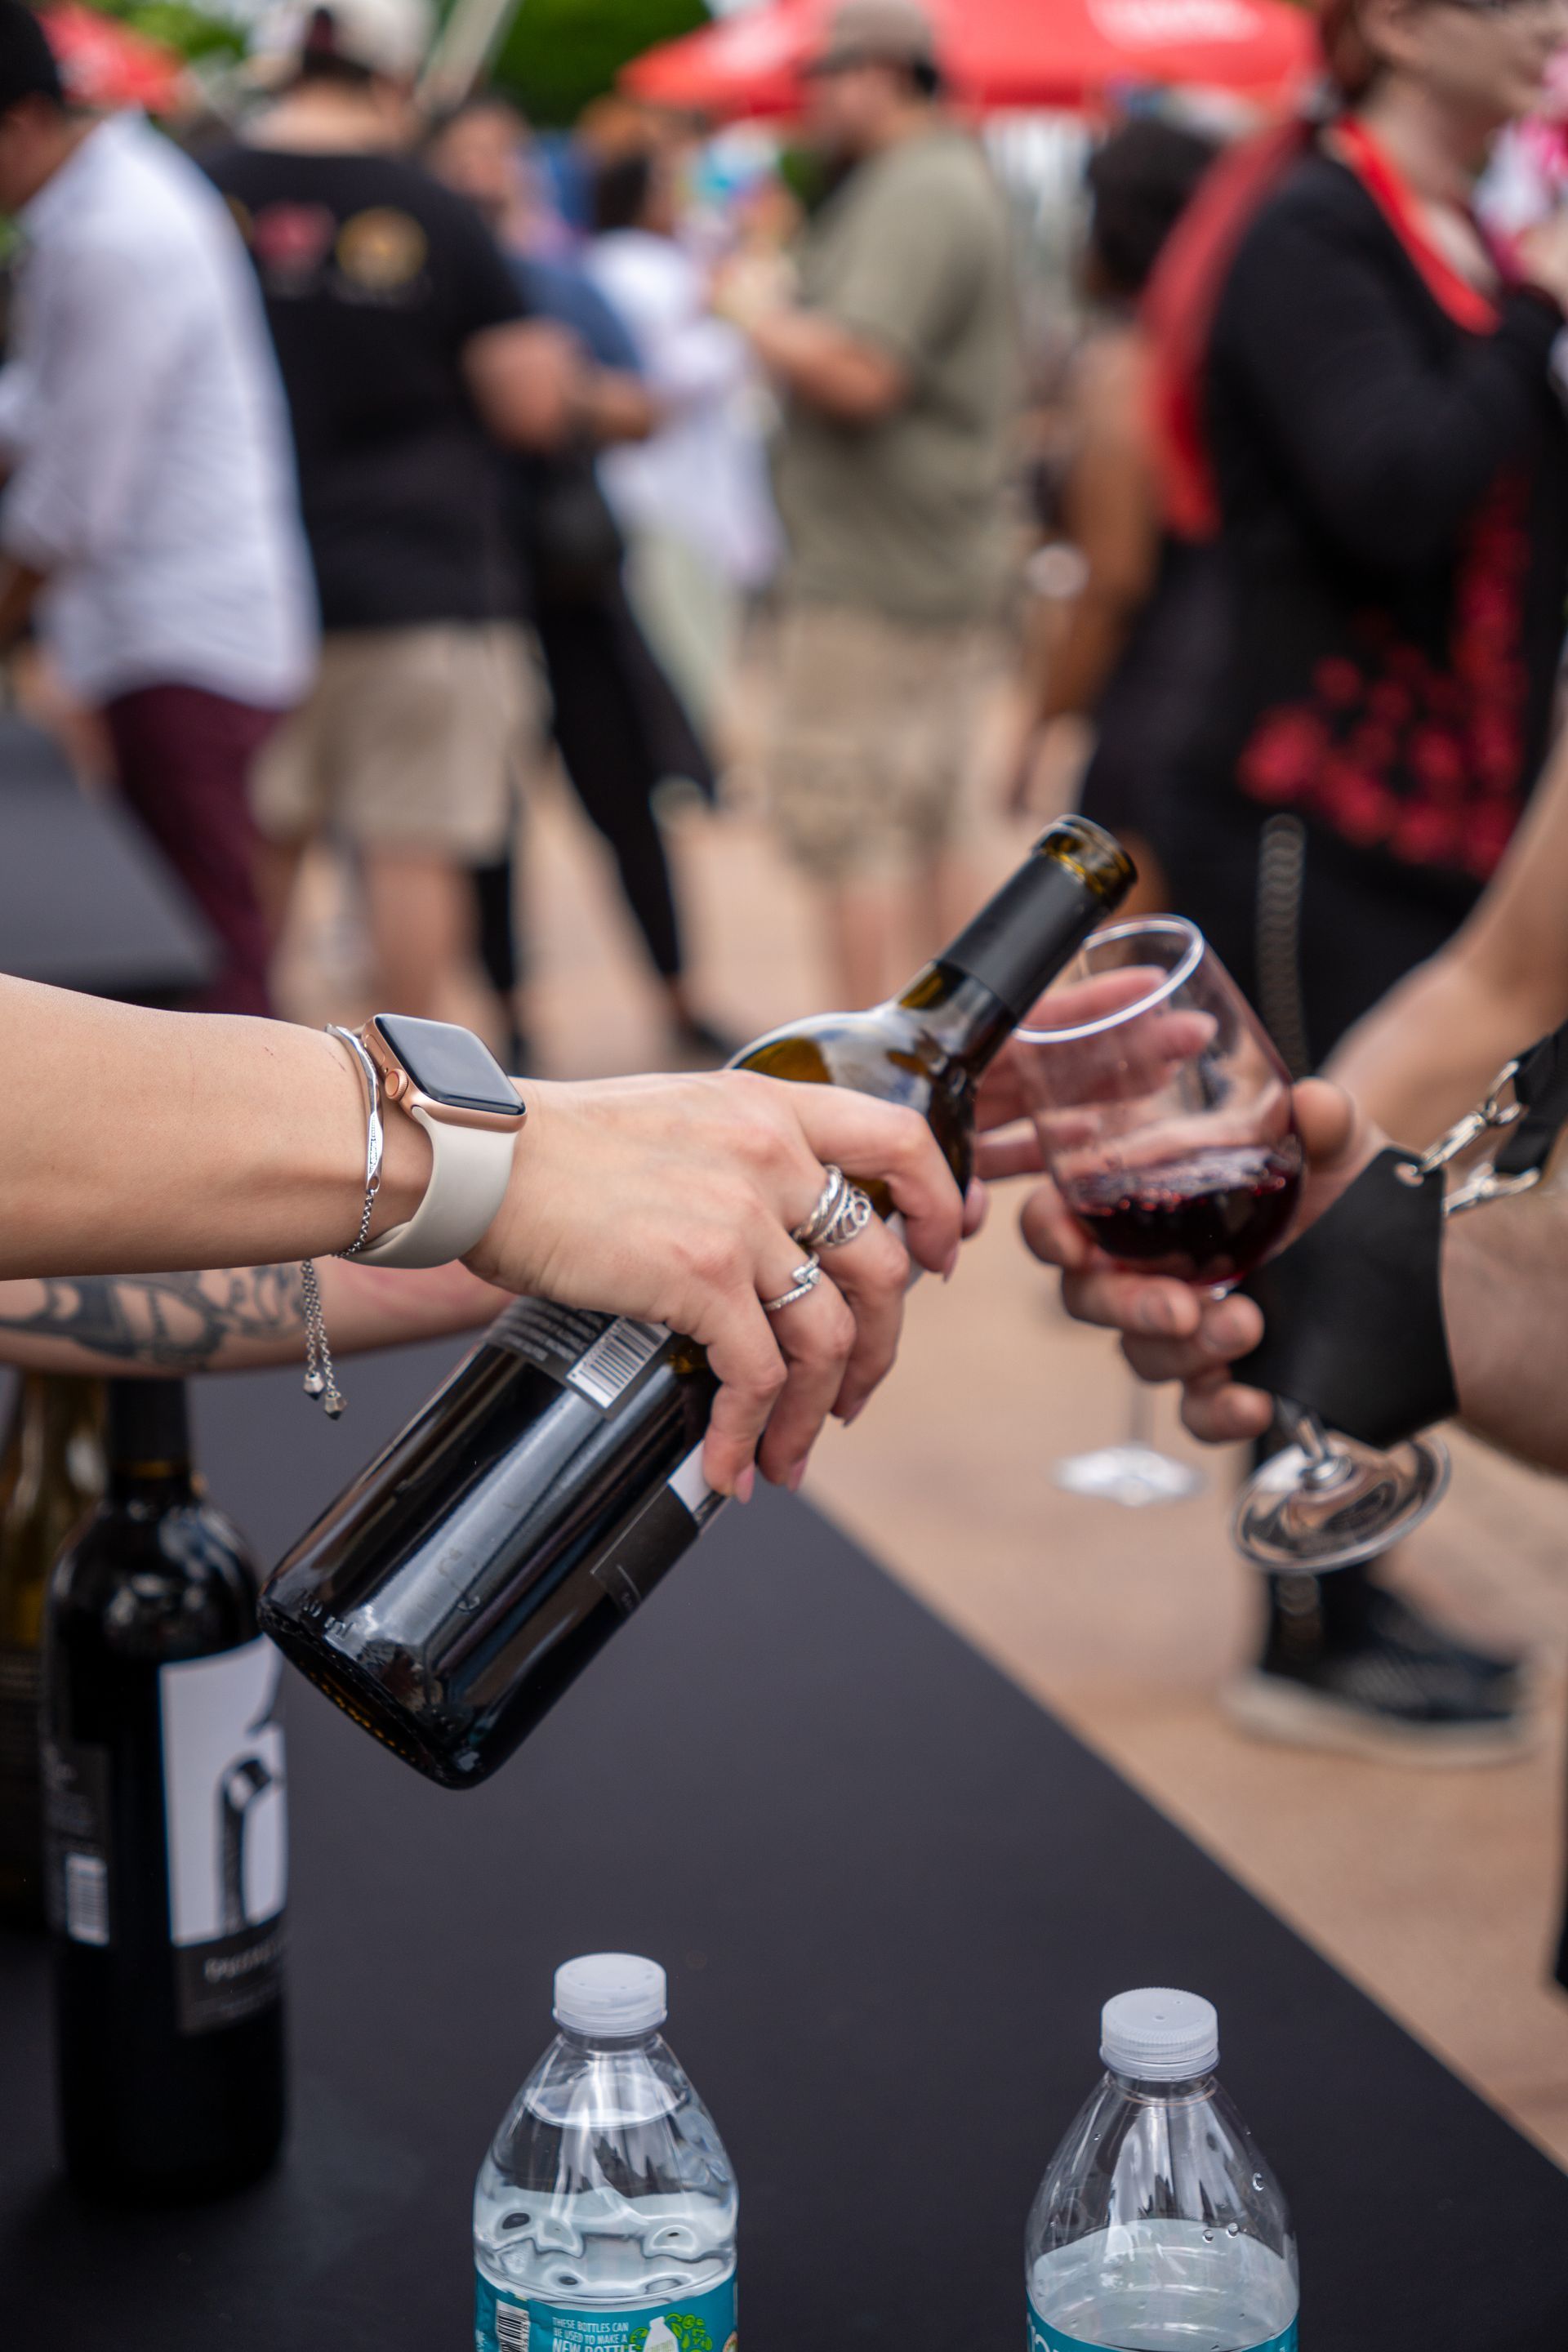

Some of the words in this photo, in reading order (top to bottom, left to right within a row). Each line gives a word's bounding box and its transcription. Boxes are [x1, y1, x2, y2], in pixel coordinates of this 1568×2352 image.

[552, 2317, 575, 2328] THESE
[577, 2322, 610, 2332] BOTTLES
[612, 2322, 629, 2332] CAN
[554, 2328, 563, 2337] BE
[564, 2330, 583, 2342] USED
[585, 2335, 595, 2345] TO
[598, 2334, 619, 2344] MAKE
[621, 2334, 628, 2342] A
[552, 2338, 581, 2352] NEW
